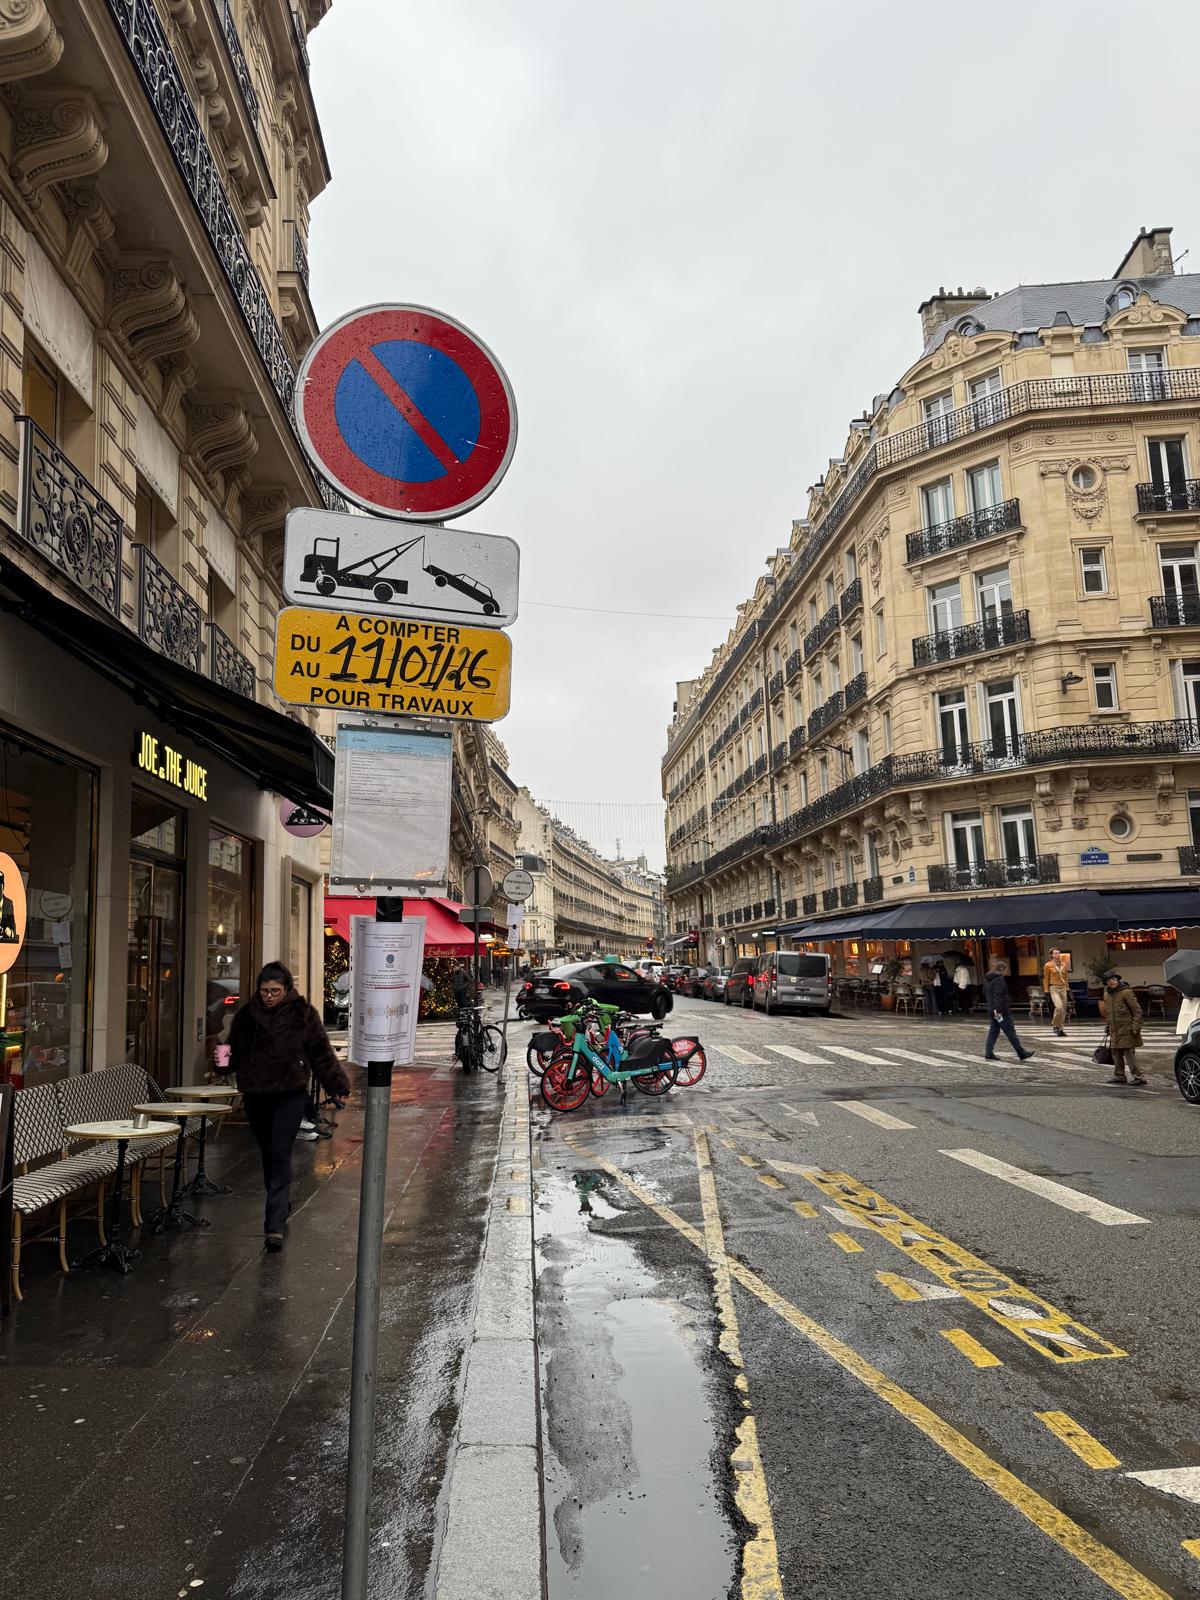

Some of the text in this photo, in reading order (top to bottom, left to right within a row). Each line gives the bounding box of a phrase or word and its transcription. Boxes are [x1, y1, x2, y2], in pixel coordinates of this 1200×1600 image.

[335, 615, 460, 644] A COMPTER
[290, 633, 321, 653] DU
[290, 660, 321, 678] AU
[310, 686, 474, 717] POUR TRAVAUX
[138, 731, 208, 802] JOE & THE JUICE
[950, 928, 986, 937] ANNA
